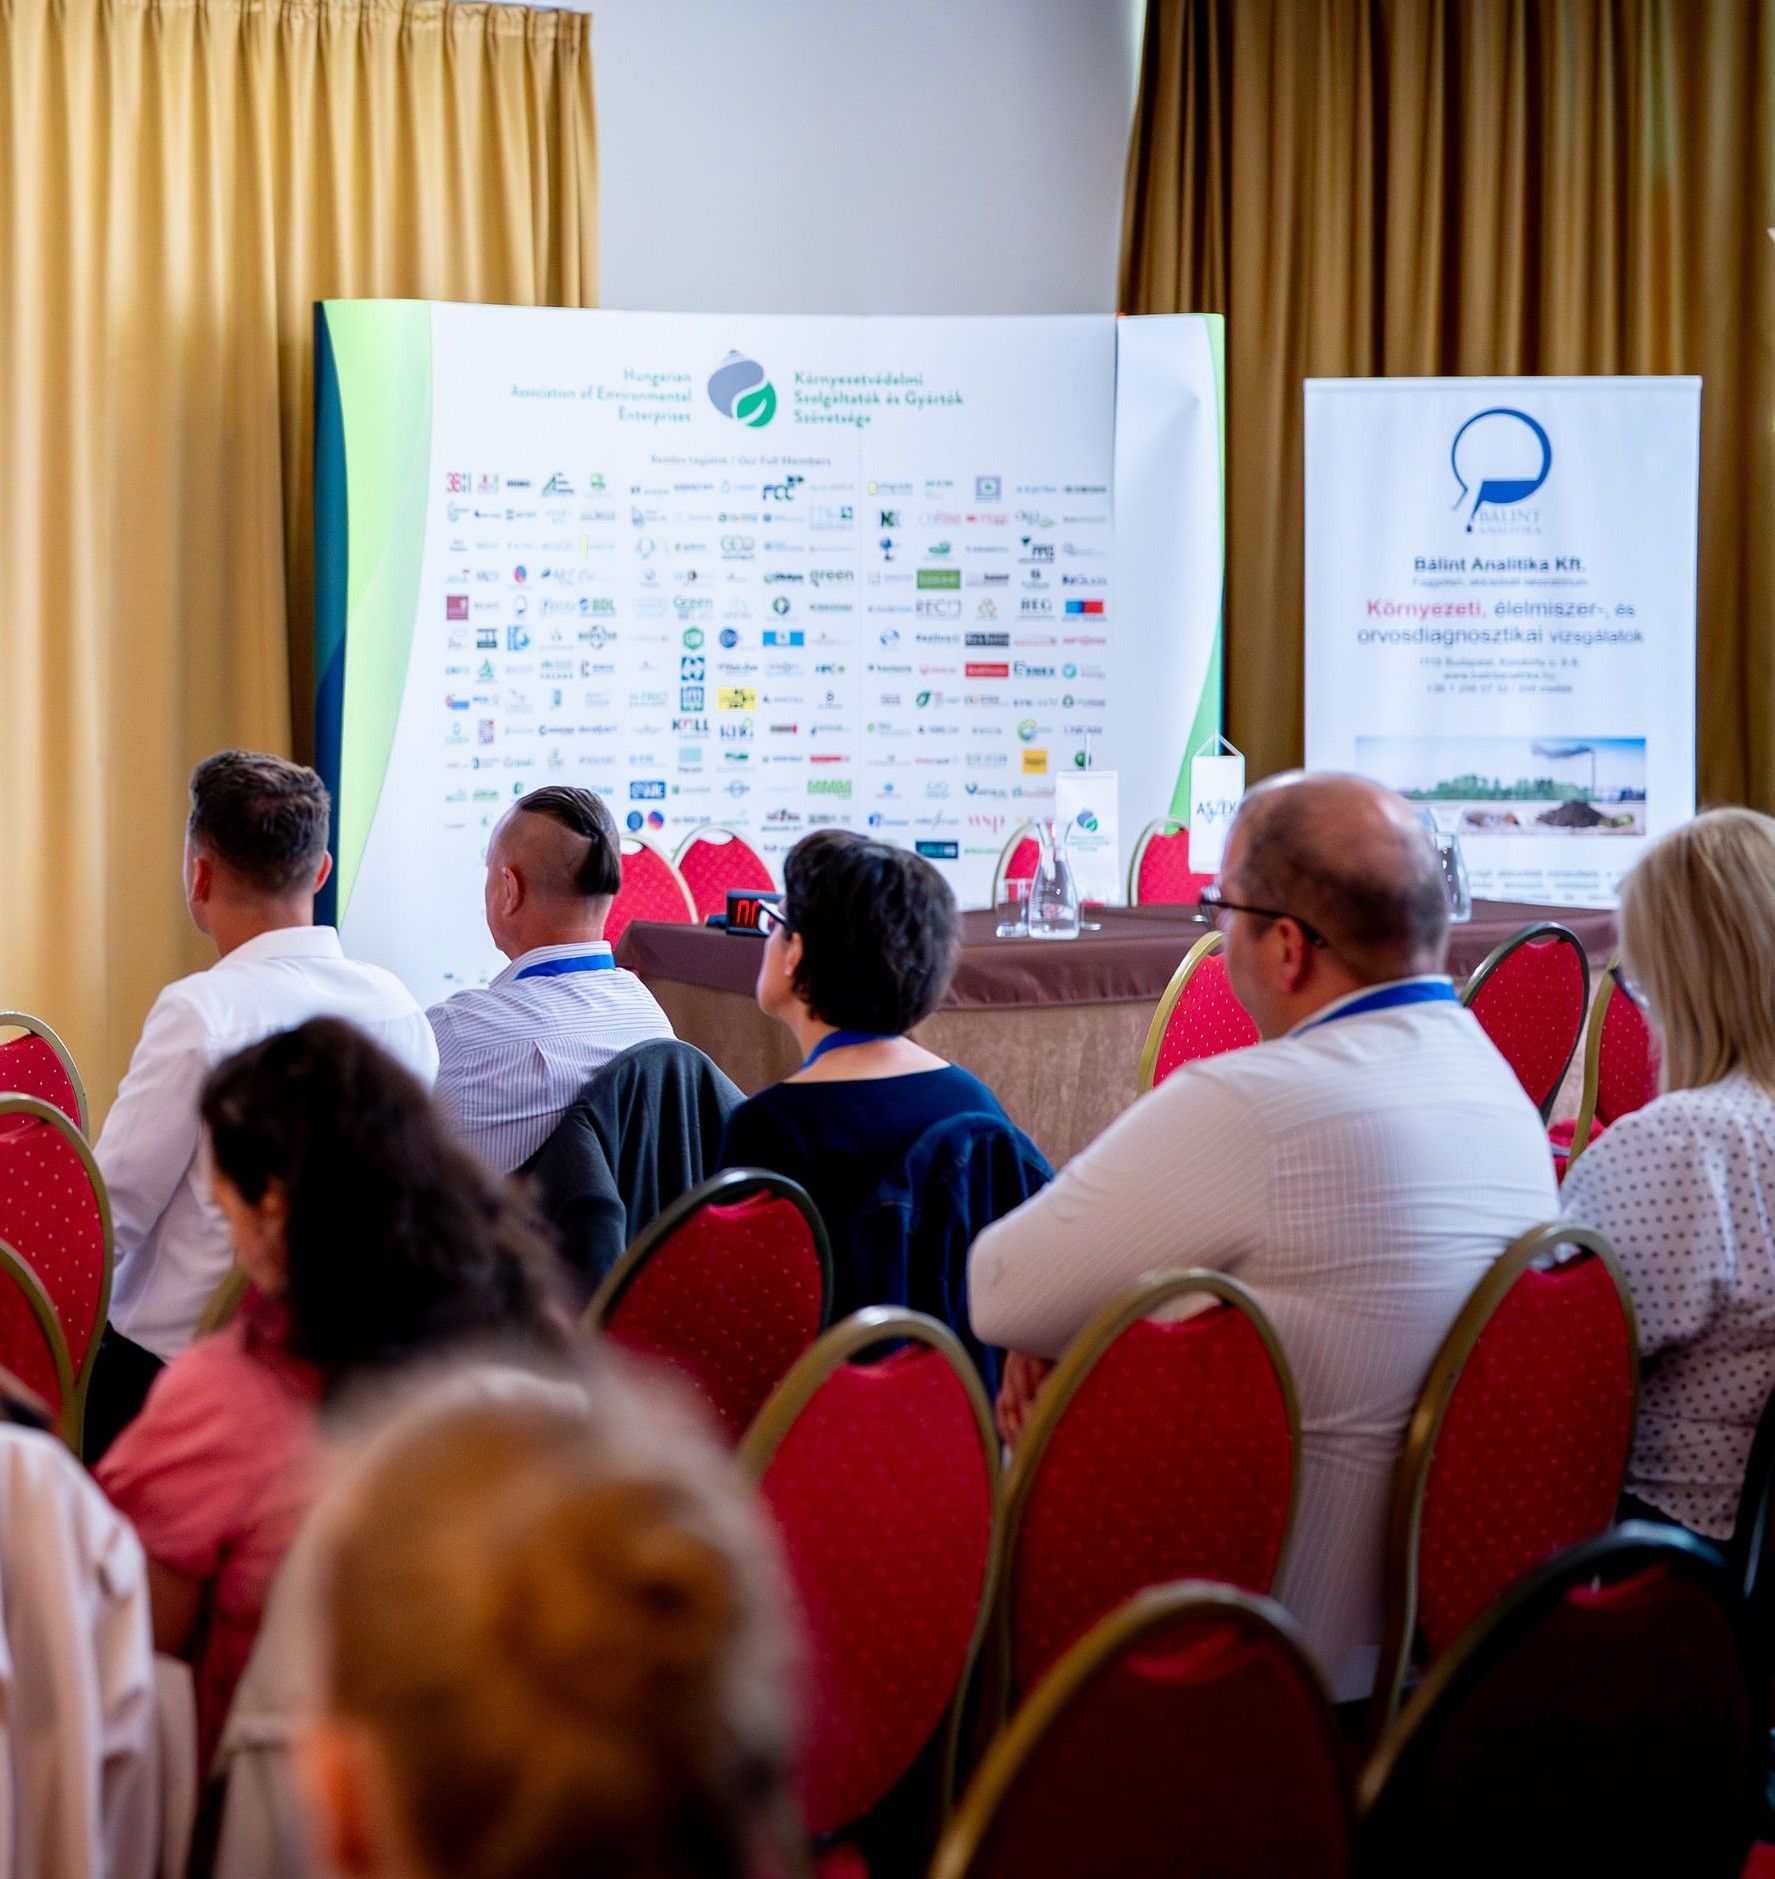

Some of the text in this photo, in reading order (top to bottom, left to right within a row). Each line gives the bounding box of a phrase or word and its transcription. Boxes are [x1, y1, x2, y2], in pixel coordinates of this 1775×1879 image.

[623, 367, 692, 387] Hungarian
[580, 384, 593, 399] of
[618, 405, 691, 425] Enterprises
[1414, 556, 1466, 572] Bálint
[1472, 556, 1550, 572] Analitika
[1366, 599, 1487, 619] Környezeti,
[1357, 626, 1643, 646] orvosdiagnosztikai vizsgálatok
